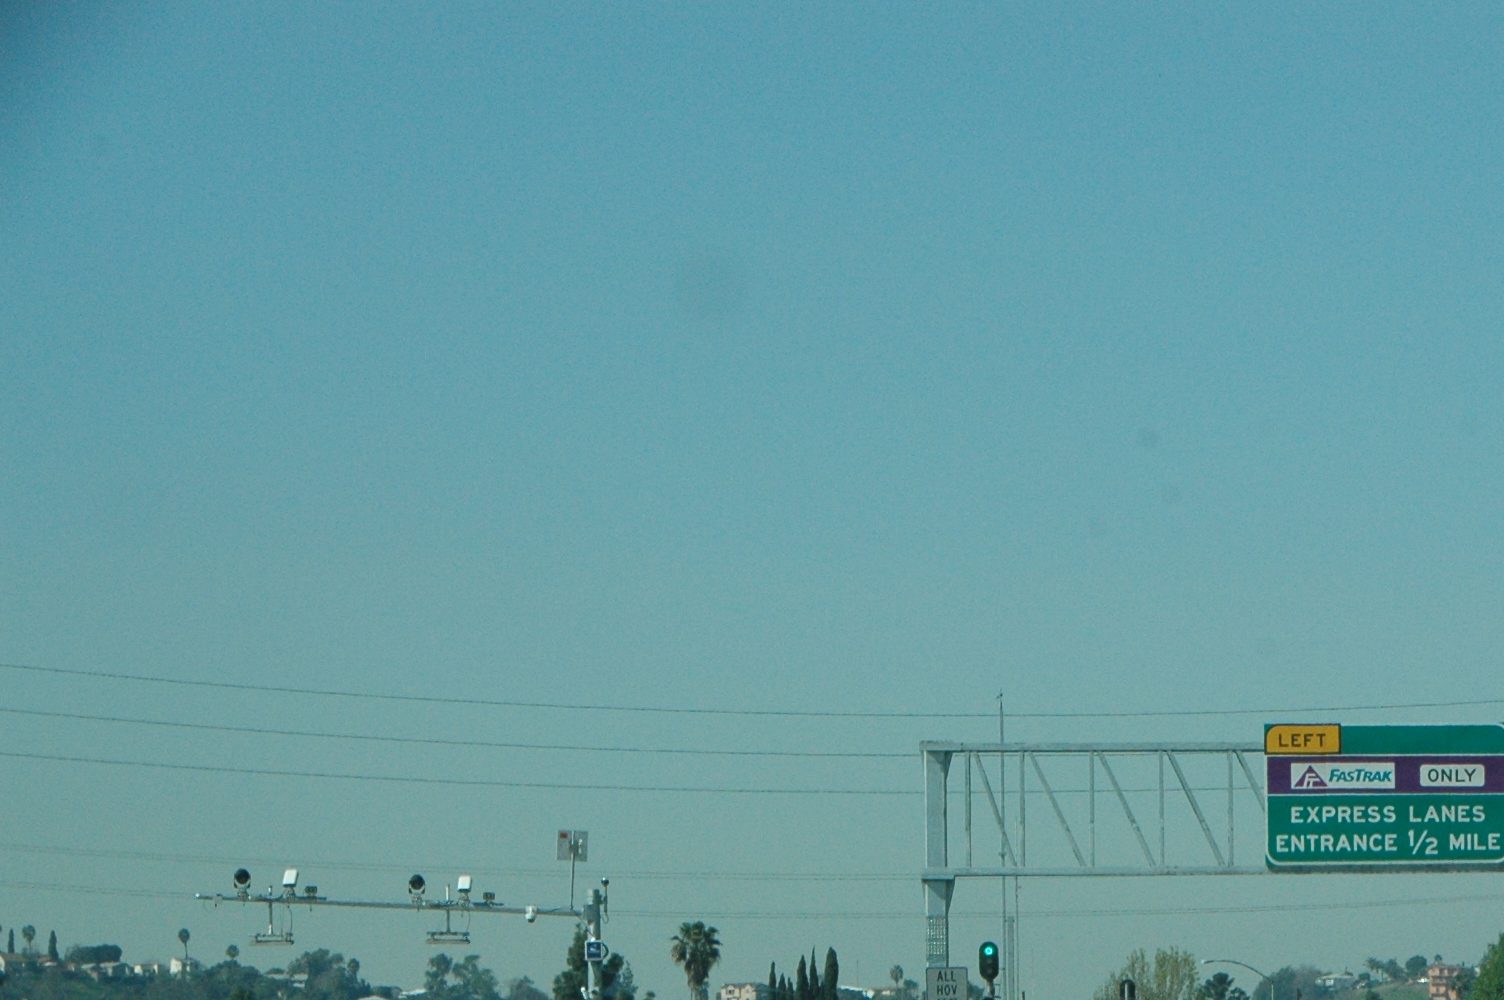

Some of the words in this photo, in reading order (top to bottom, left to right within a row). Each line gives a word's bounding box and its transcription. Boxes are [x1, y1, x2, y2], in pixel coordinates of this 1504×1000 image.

[1279, 733, 1326, 748] LEFT
[1427, 768, 1477, 783] ONLY
[1291, 806, 1397, 824] EXPRESS
[1408, 805, 1486, 823] LANES
[1276, 833, 1398, 853] ENTRANCE
[1449, 833, 1501, 850] MILE
[937, 970, 957, 982] ALL
[936, 984, 958, 996] HOV
